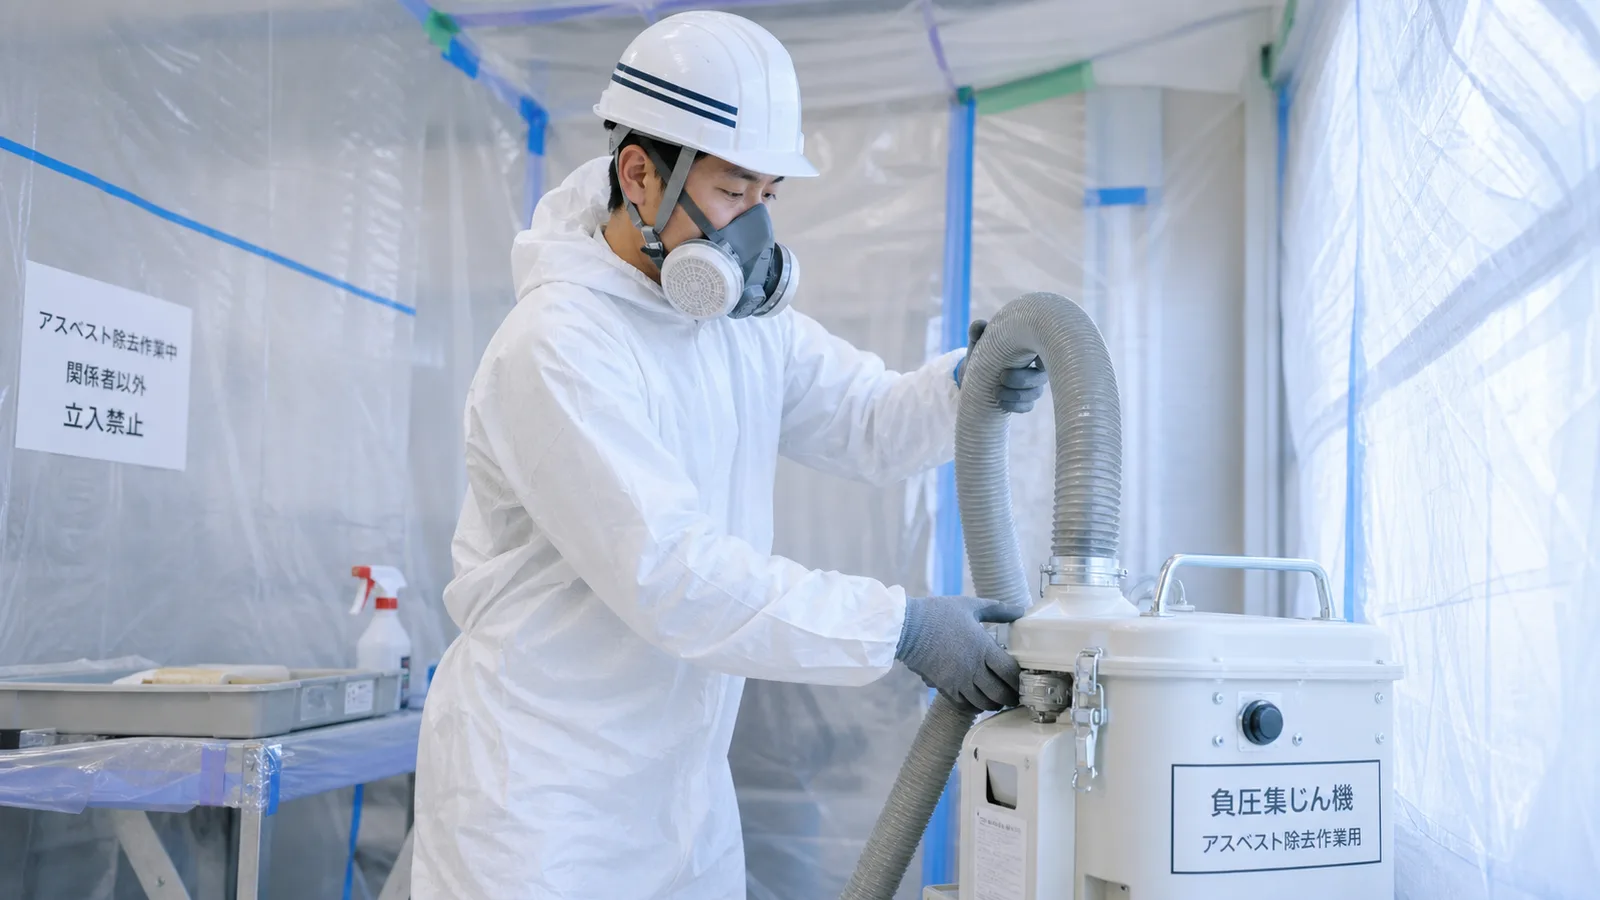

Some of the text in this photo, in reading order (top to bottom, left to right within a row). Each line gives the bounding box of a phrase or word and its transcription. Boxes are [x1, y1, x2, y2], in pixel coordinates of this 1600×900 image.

[39, 311, 178, 360] アスベスト除去作業中
[66, 360, 146, 396] 関係者以外
[63, 402, 144, 437] 立入禁止
[1211, 784, 1354, 817] 負圧集じん機
[1202, 827, 1362, 854] アスベスト除去作業用
